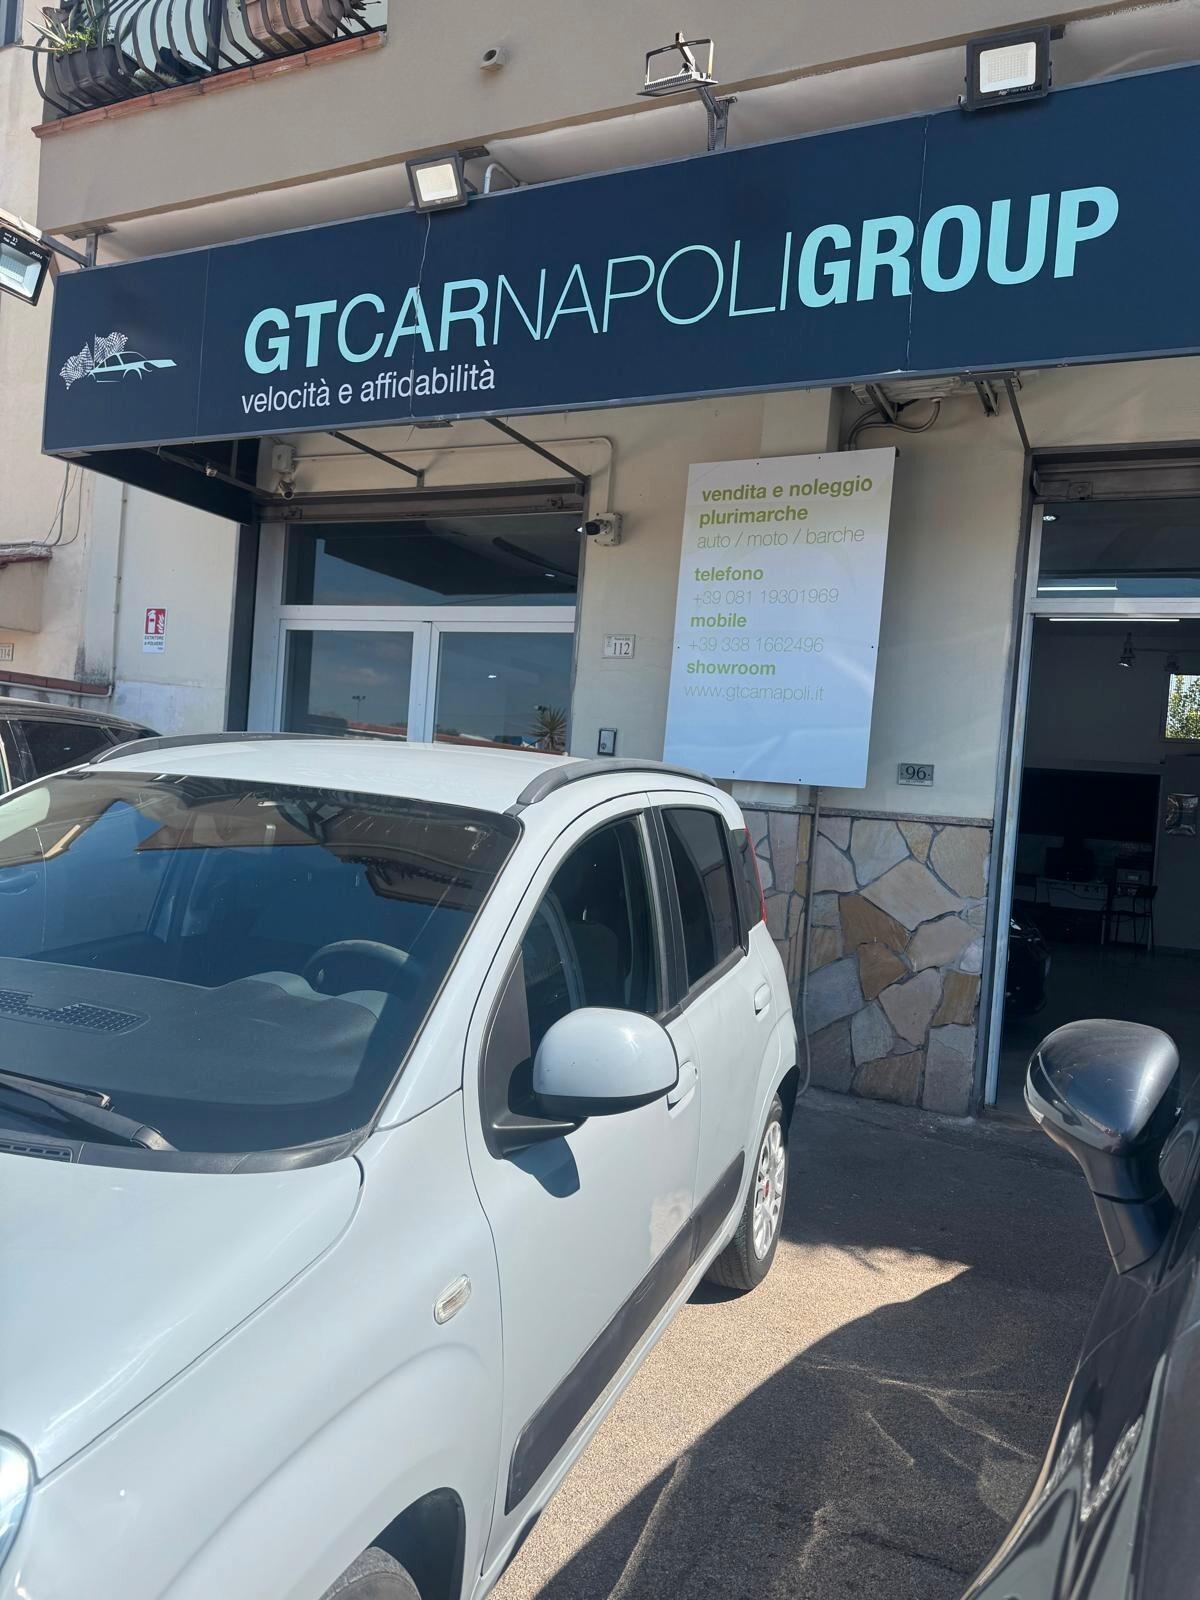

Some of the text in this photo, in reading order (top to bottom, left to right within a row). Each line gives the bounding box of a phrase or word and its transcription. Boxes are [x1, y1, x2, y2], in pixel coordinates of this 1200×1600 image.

[241, 359, 496, 414] velocità e affidabilità
[702, 475, 873, 502] vendita e noleggio
[699, 505, 808, 528] plurimarche
[697, 532, 731, 549] auto
[747, 530, 788, 547] moto
[806, 526, 866, 545] barche
[694, 566, 764, 582] telefono
[693, 587, 839, 605] +39 081 19301969
[690, 612, 747, 628] mobile
[613, 642, 630, 655] 112
[688, 637, 717, 652] +39
[756, 636, 824, 653] 1662496
[686, 659, 776, 676] showroom
[905, 765, 927, 780] 96
